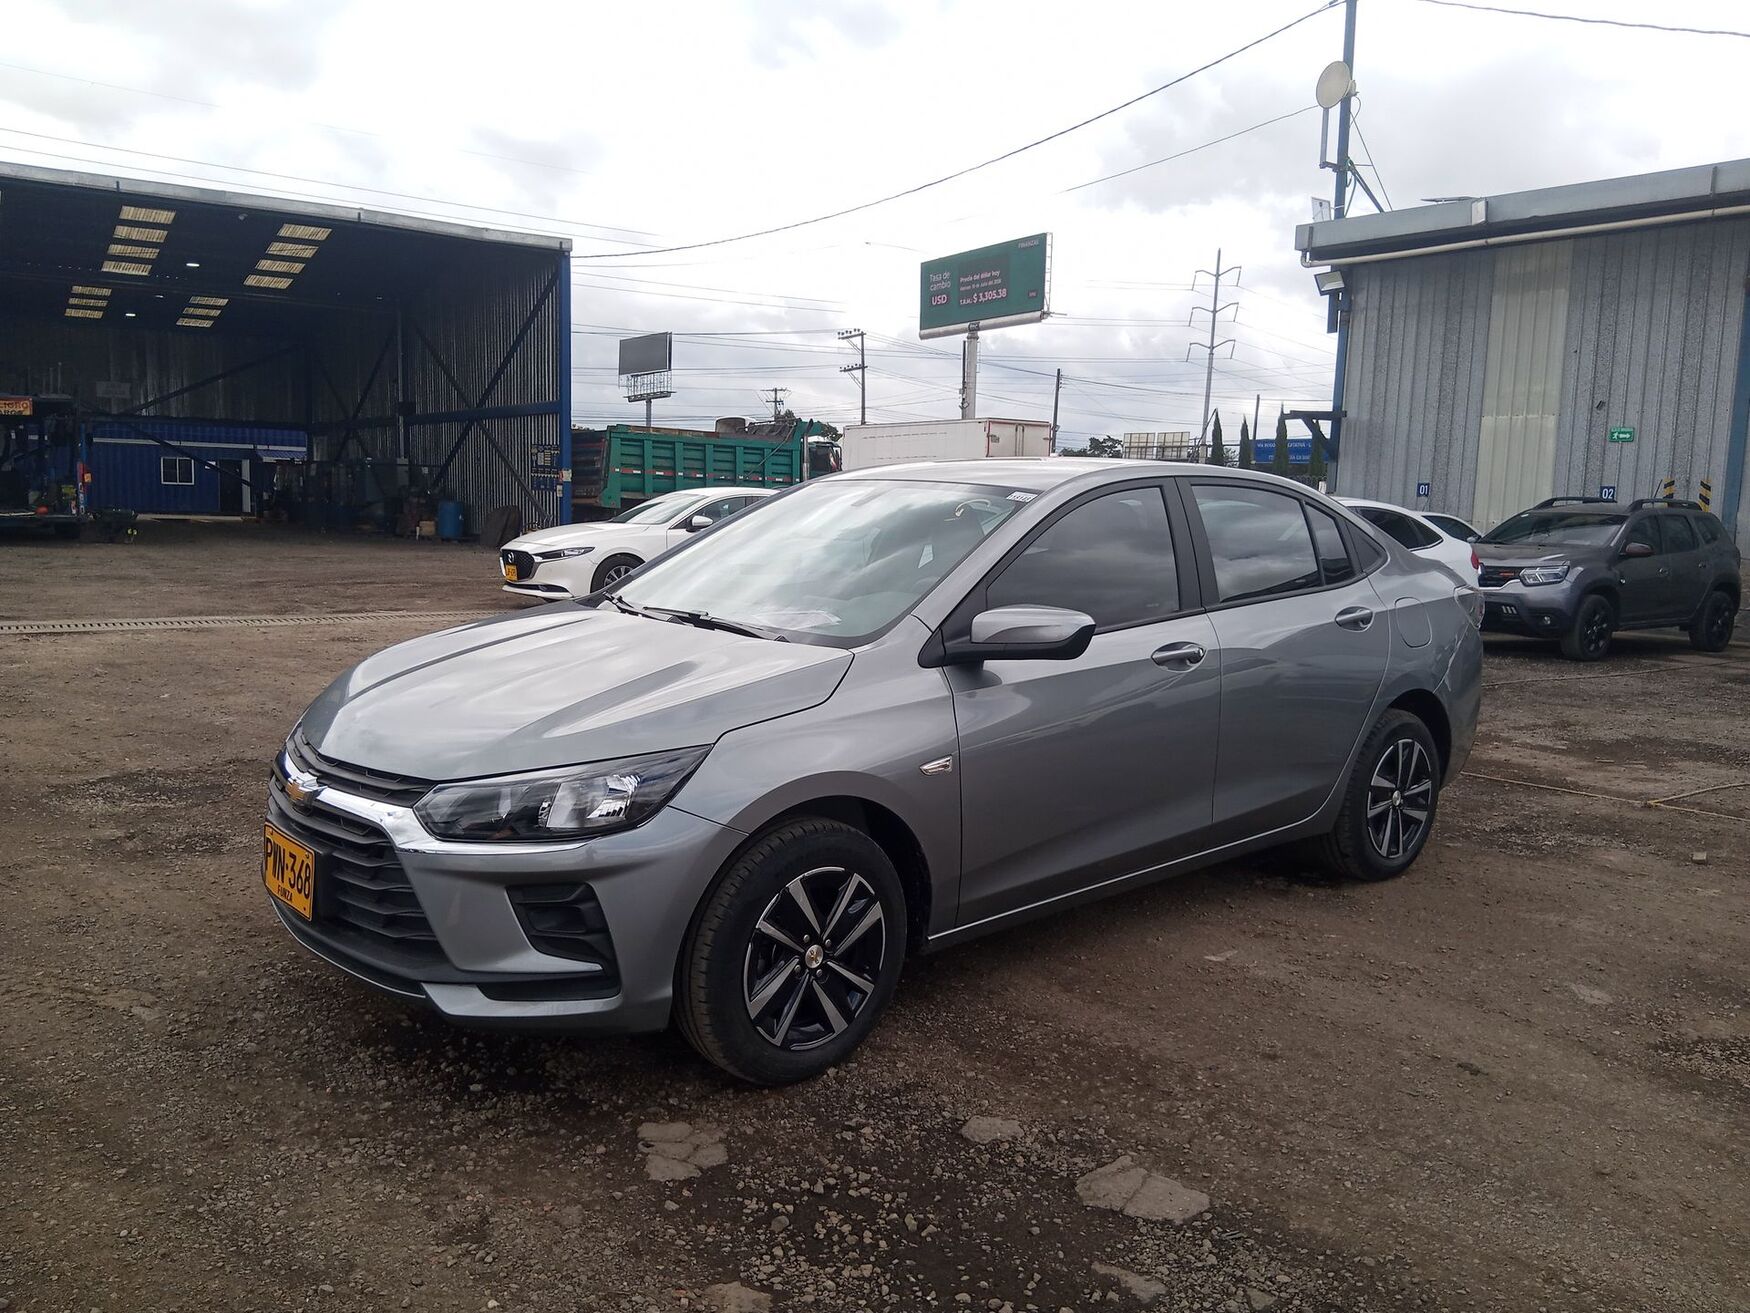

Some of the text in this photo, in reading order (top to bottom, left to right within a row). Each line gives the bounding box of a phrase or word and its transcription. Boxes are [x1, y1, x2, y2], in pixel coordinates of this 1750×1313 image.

[929, 271, 950, 282] Tasa de
[991, 269, 1000, 278] hoy
[930, 280, 951, 291] cambio
[932, 294, 947, 305] USD
[973, 292, 978, 303] $
[979, 289, 1007, 302] 3,305.38
[1419, 485, 1429, 495] 01
[1602, 488, 1614, 499] 02
[277, 884, 293, 901] FUNZA
